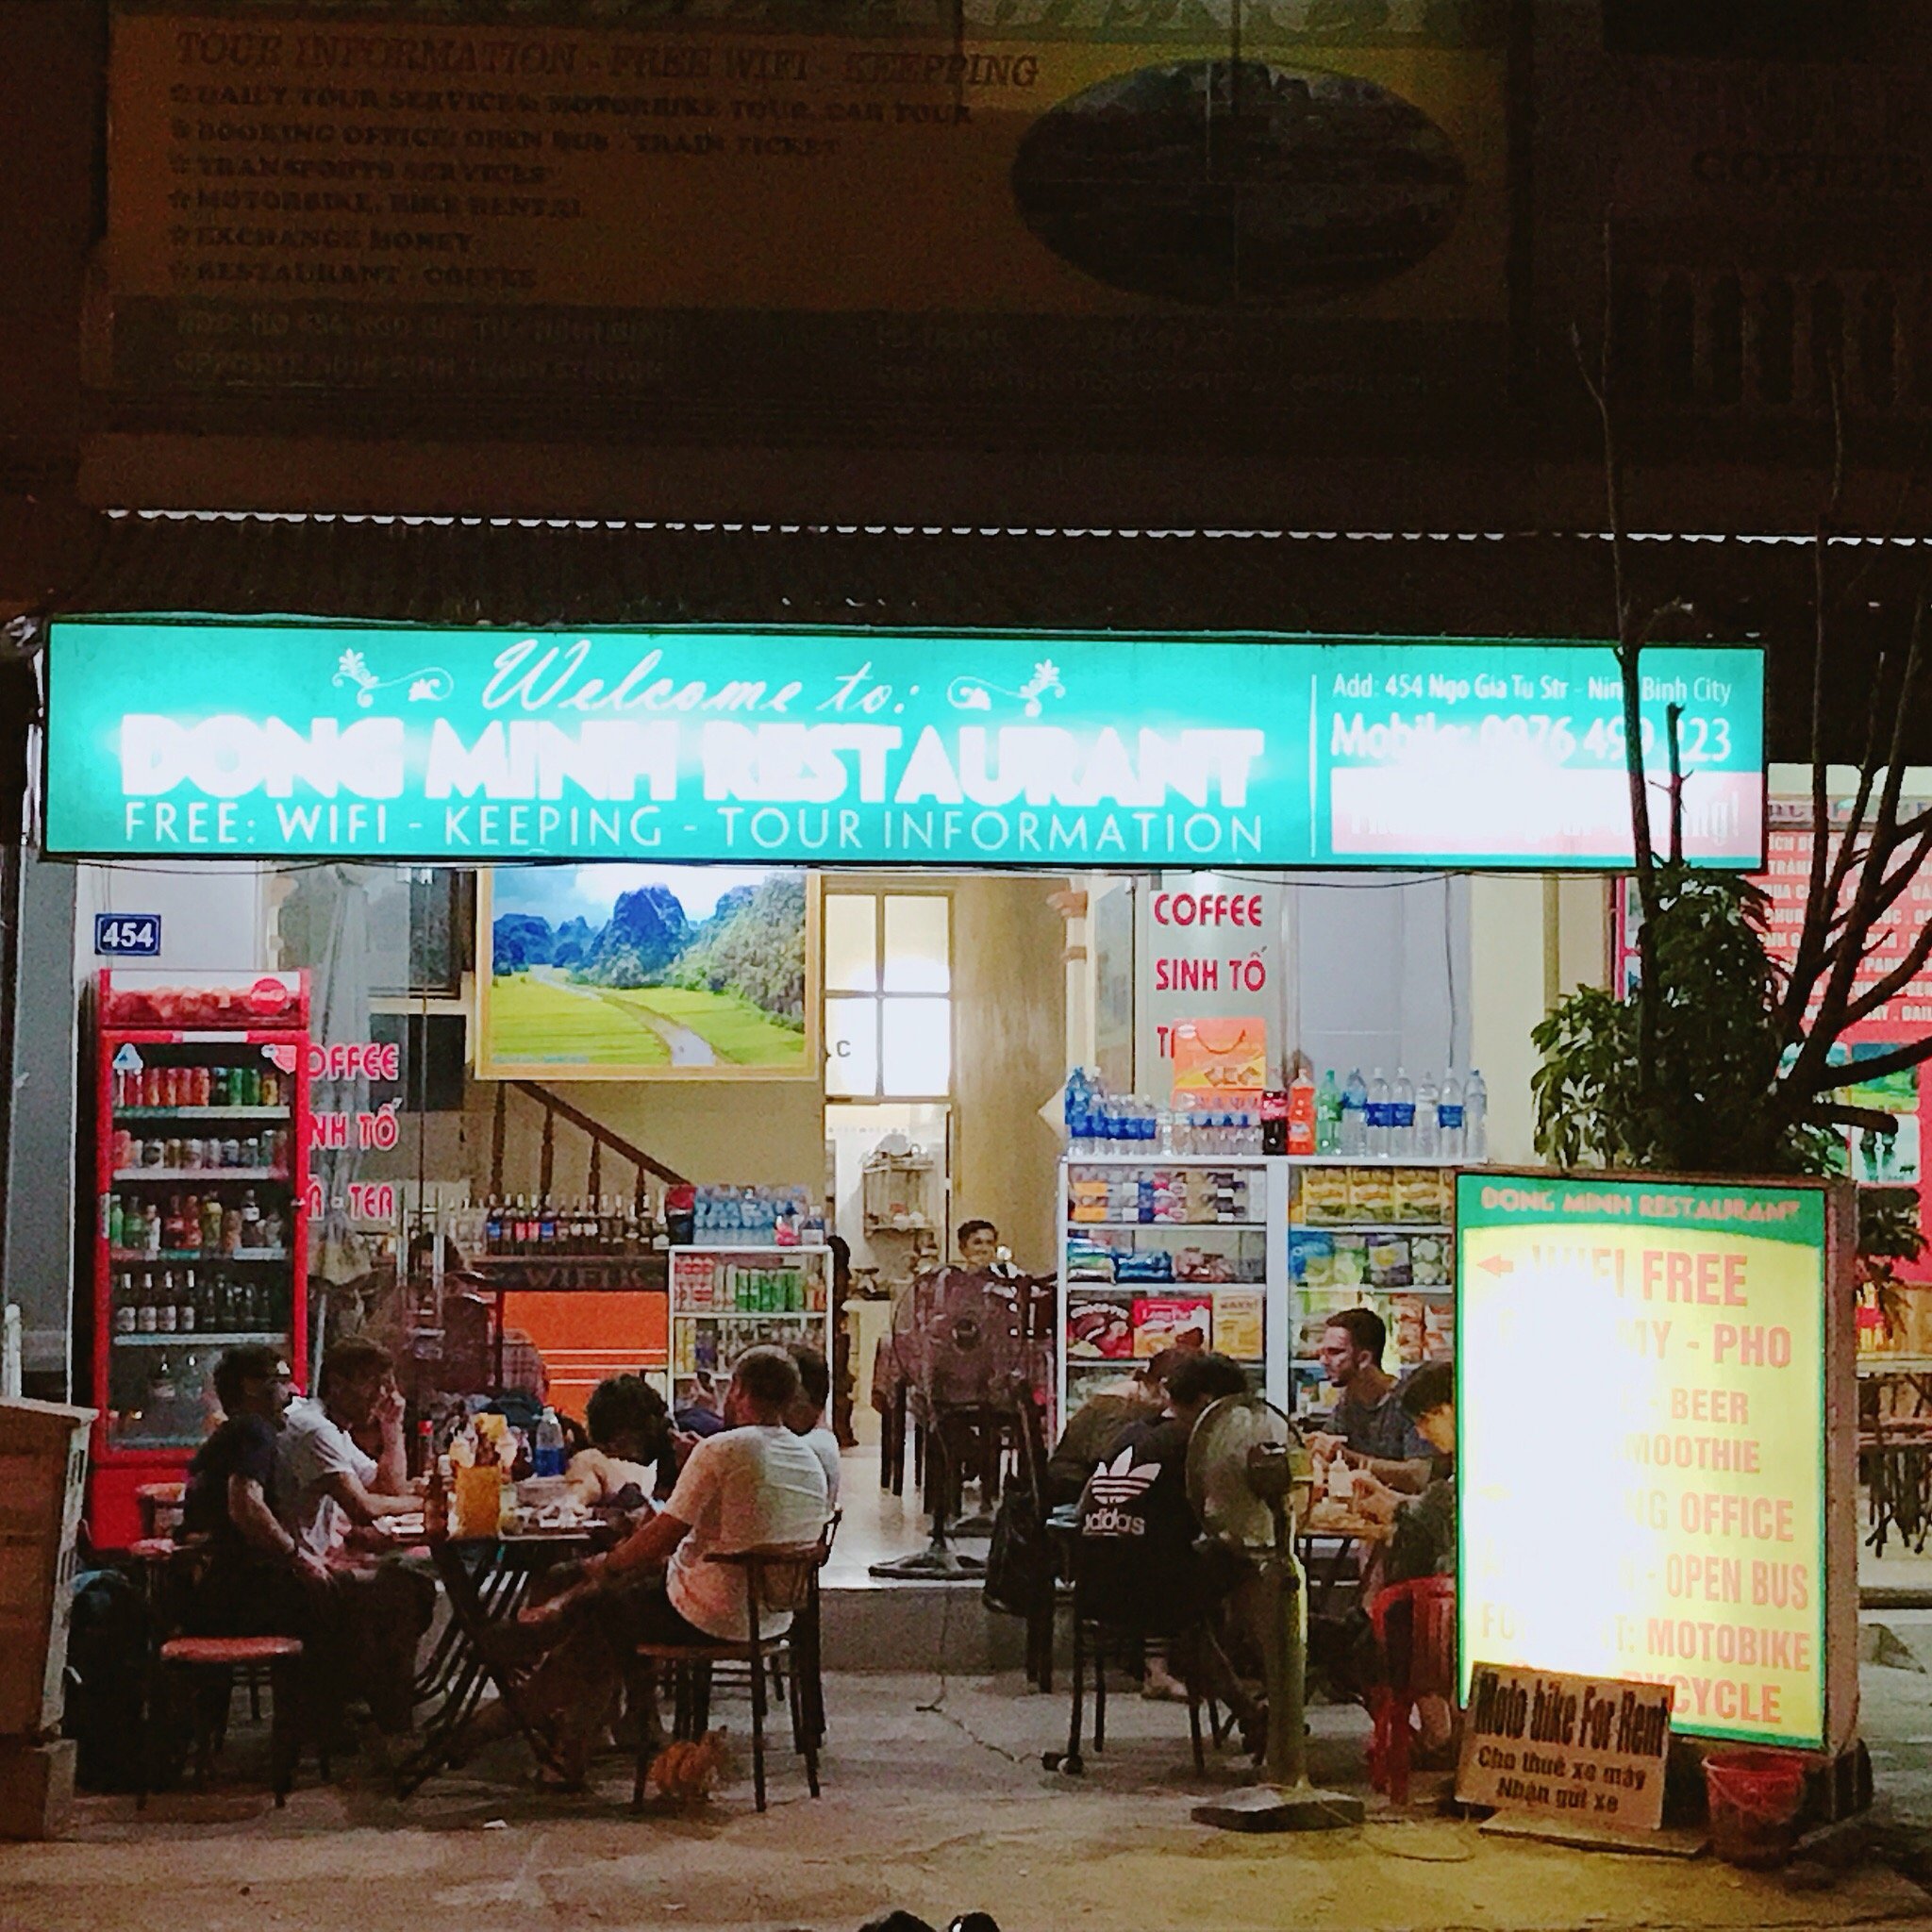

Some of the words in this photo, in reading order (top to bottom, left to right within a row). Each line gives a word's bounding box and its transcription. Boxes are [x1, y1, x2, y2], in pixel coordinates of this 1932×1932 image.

[482, 639, 802, 712] Welcome
[817, 660, 920, 714] to:
[1385, 674, 1423, 699] 454
[1428, 674, 1471, 705] Ngo
[1474, 674, 1507, 699] Gia
[1511, 675, 1535, 699] Tu
[1540, 675, 1570, 699] Str
[1588, 676, 1625, 701] Nin
[1641, 675, 1688, 701] Binh
[1693, 676, 1732, 707] City
[120, 713, 404, 798] DONG
[425, 717, 678, 801] MINH
[702, 721, 1265, 808] RESTAURANT
[1675, 716, 1732, 763] 23
[125, 802, 257, 845] FREE:
[276, 803, 388, 845] WIFI
[445, 805, 661, 847] KEEPING
[717, 807, 863, 849] TOUR
[885, 810, 1262, 854] INFORMATION
[1154, 893, 1263, 926] COFFEE
[103, 922, 154, 947] 454
[1156, 958, 1218, 991] SINH
[1229, 945, 1267, 991] TỐ
[309, 1044, 399, 1080] OFFEE
[310, 1111, 348, 1150] NH
[1639, 1194, 1800, 1223] RESTAURANT
[1643, 1249, 1748, 1307] FREE
[1713, 1324, 1791, 1369] PHO
[1672, 1388, 1749, 1424] BEER
[1613, 1432, 1761, 1474] MOOTHIE
[1681, 1491, 1794, 1542] OFFICE
[1667, 1553, 1742, 1605] OPEN
[1751, 1559, 1809, 1610] BUS
[1647, 1618, 1811, 1673] MOTOBIKE
[1623, 1671, 1783, 1724] CYCLE
[1478, 1745, 1517, 1771] Cho
[1572, 1761, 1597, 1782] xe
[1594, 1792, 1620, 1813] xe
